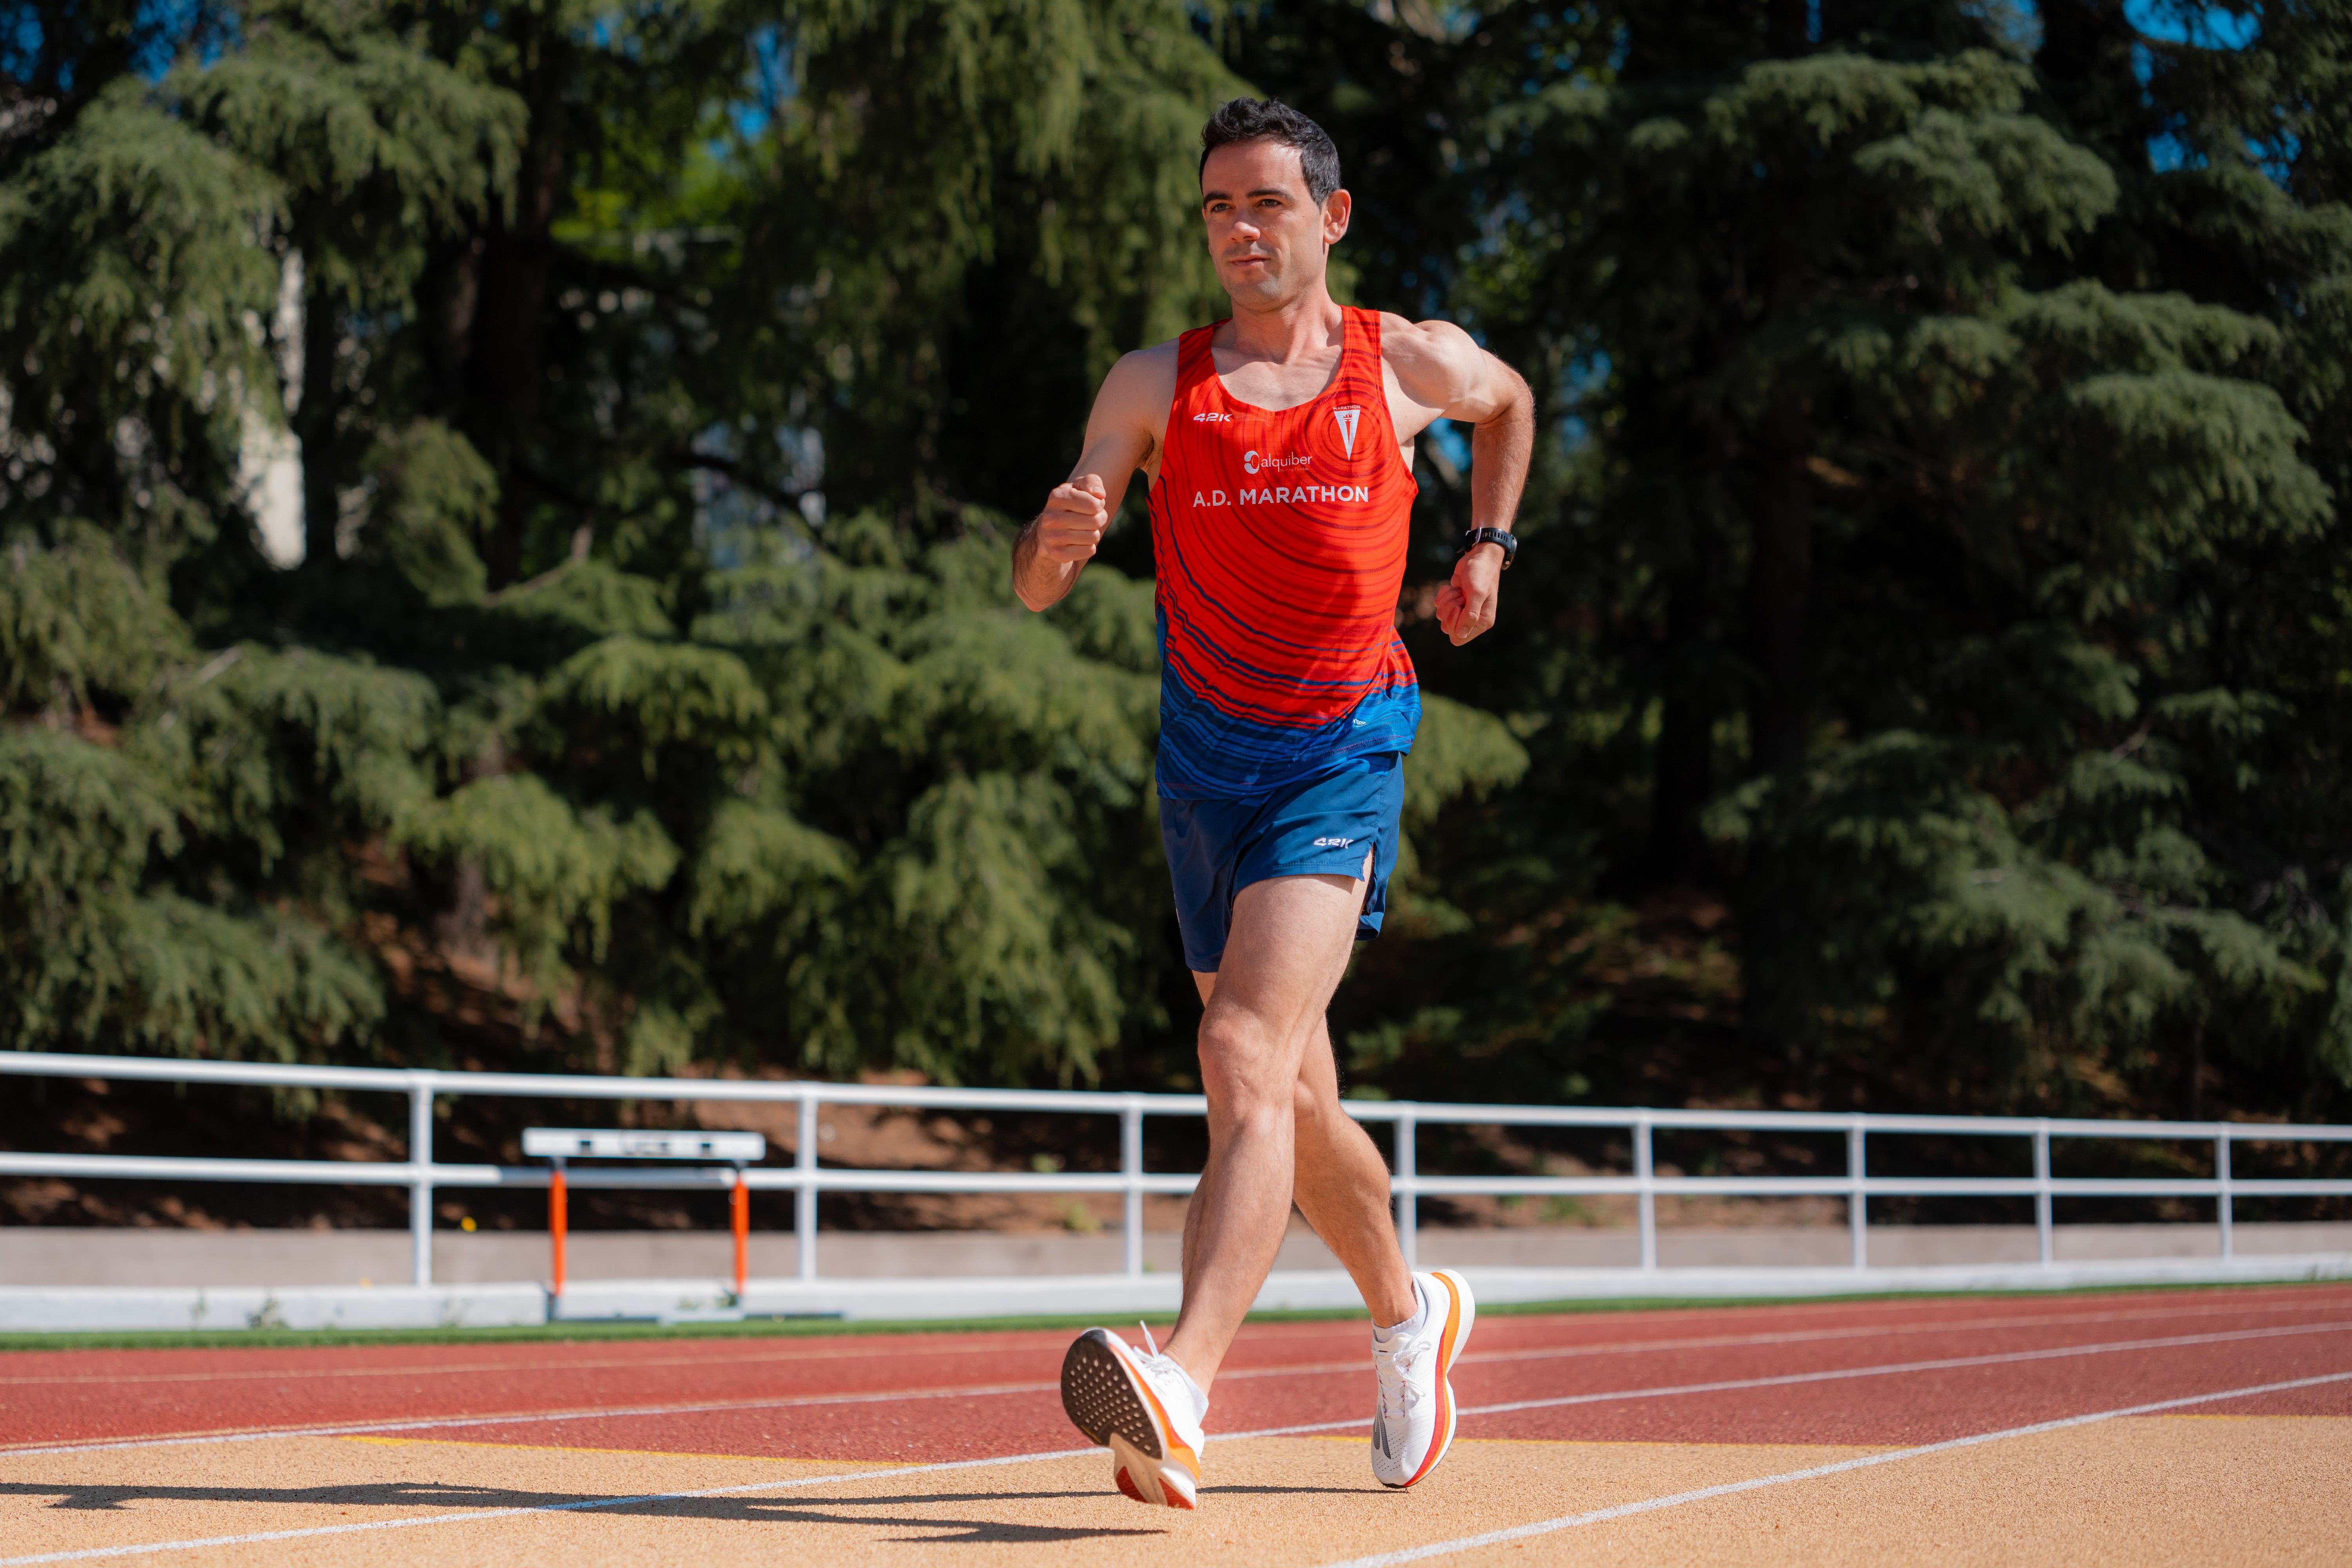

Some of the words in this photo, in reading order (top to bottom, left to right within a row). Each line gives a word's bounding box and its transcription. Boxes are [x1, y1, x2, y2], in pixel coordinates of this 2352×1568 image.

[1193, 412, 1233, 422] 42K
[1261, 452, 1312, 472] alquiber
[1193, 490, 1231, 507] A.D.
[1240, 486, 1368, 505] MARATHON
[1314, 837, 1354, 849] 42K
